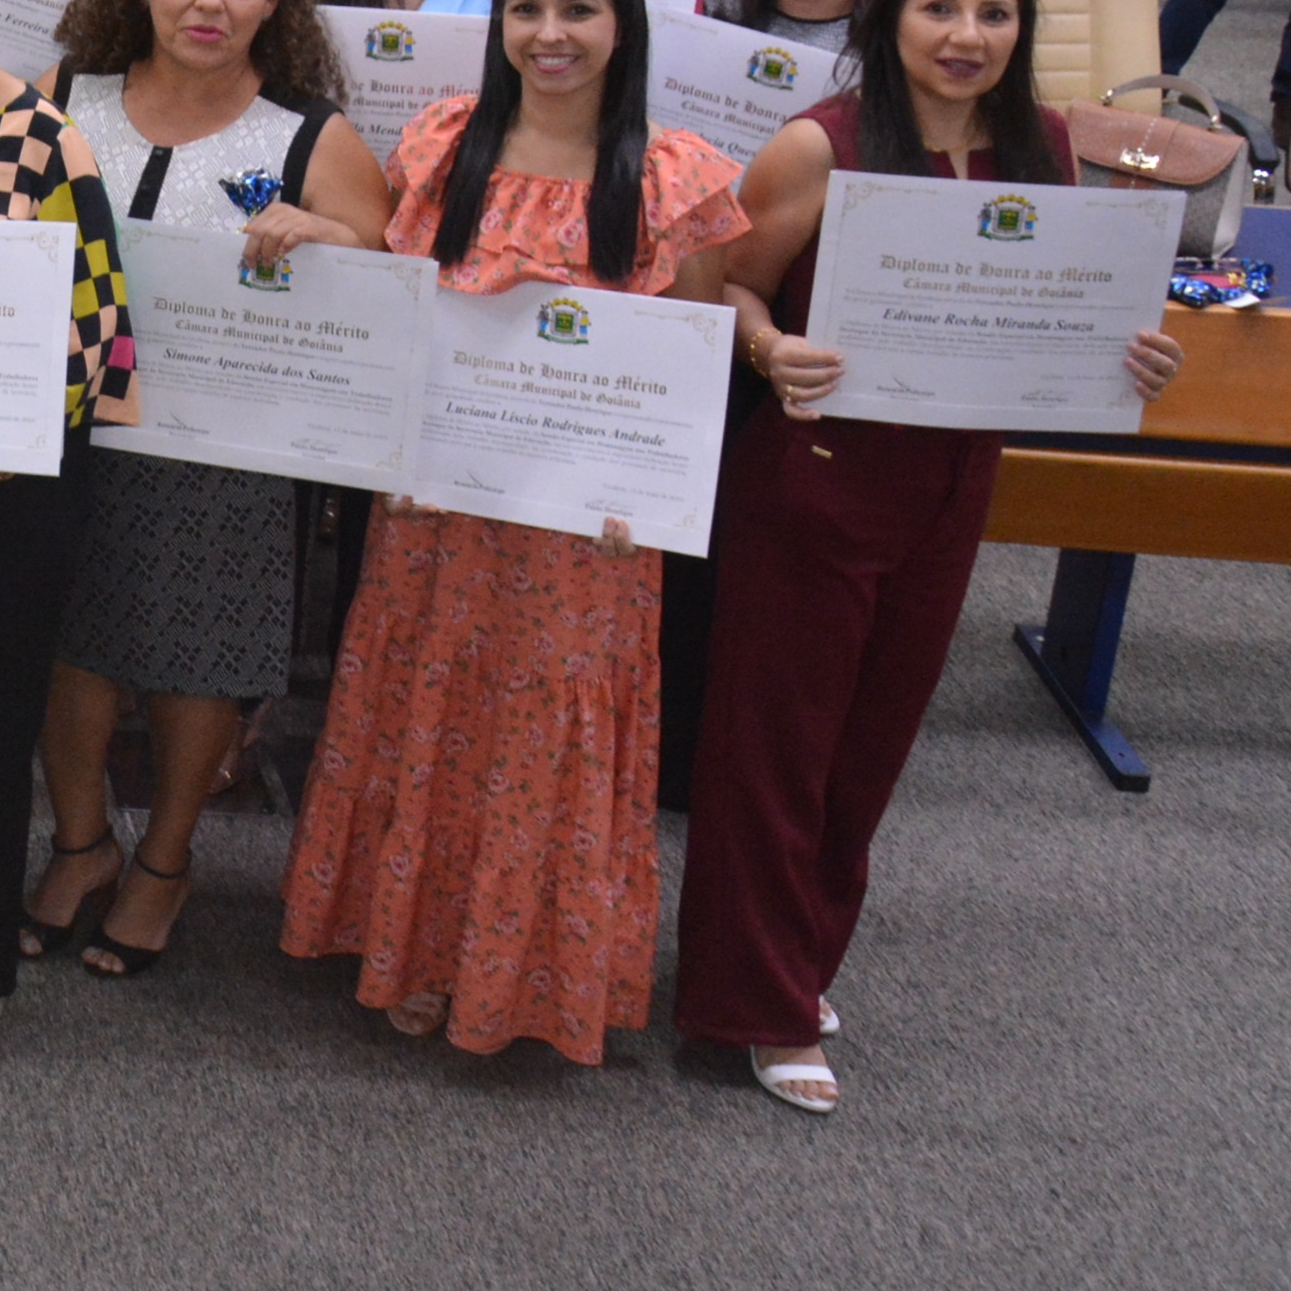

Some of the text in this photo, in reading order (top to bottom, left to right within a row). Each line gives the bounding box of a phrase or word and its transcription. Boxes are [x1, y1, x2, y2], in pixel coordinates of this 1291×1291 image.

[4, 12, 50, 35] Ferreira
[419, 86, 434, 96] ao
[664, 77, 721, 104] Diploma
[725, 96, 739, 109] de
[879, 255, 950, 277] Diploma
[954, 262, 973, 277] de
[1035, 268, 1053, 281] ao
[1058, 265, 1113, 284] Mérito
[903, 277, 1085, 300] Câmara Municipal de Goiânia
[153, 296, 216, 320] Diploma
[221, 306, 237, 322] de
[294, 318, 311, 332] ao
[316, 318, 369, 341] Mérito
[882, 308, 1095, 333] Edivane Rocha Miranda Souza
[174, 318, 344, 354] Câmara Municipal de Goiânia
[163, 347, 351, 387] Simone Aparecida dos Santos
[453, 350, 515, 375] Diploma
[519, 360, 535, 376] de
[592, 373, 610, 388] ao
[614, 372, 667, 396] Mérito
[520, 381, 577, 401] Municipal
[580, 389, 592, 403] de
[596, 390, 642, 410] Goiânia
[446, 401, 497, 421] Luciana
[541, 417, 606, 438] Rodrigues
[611, 428, 666, 448] Andrade
